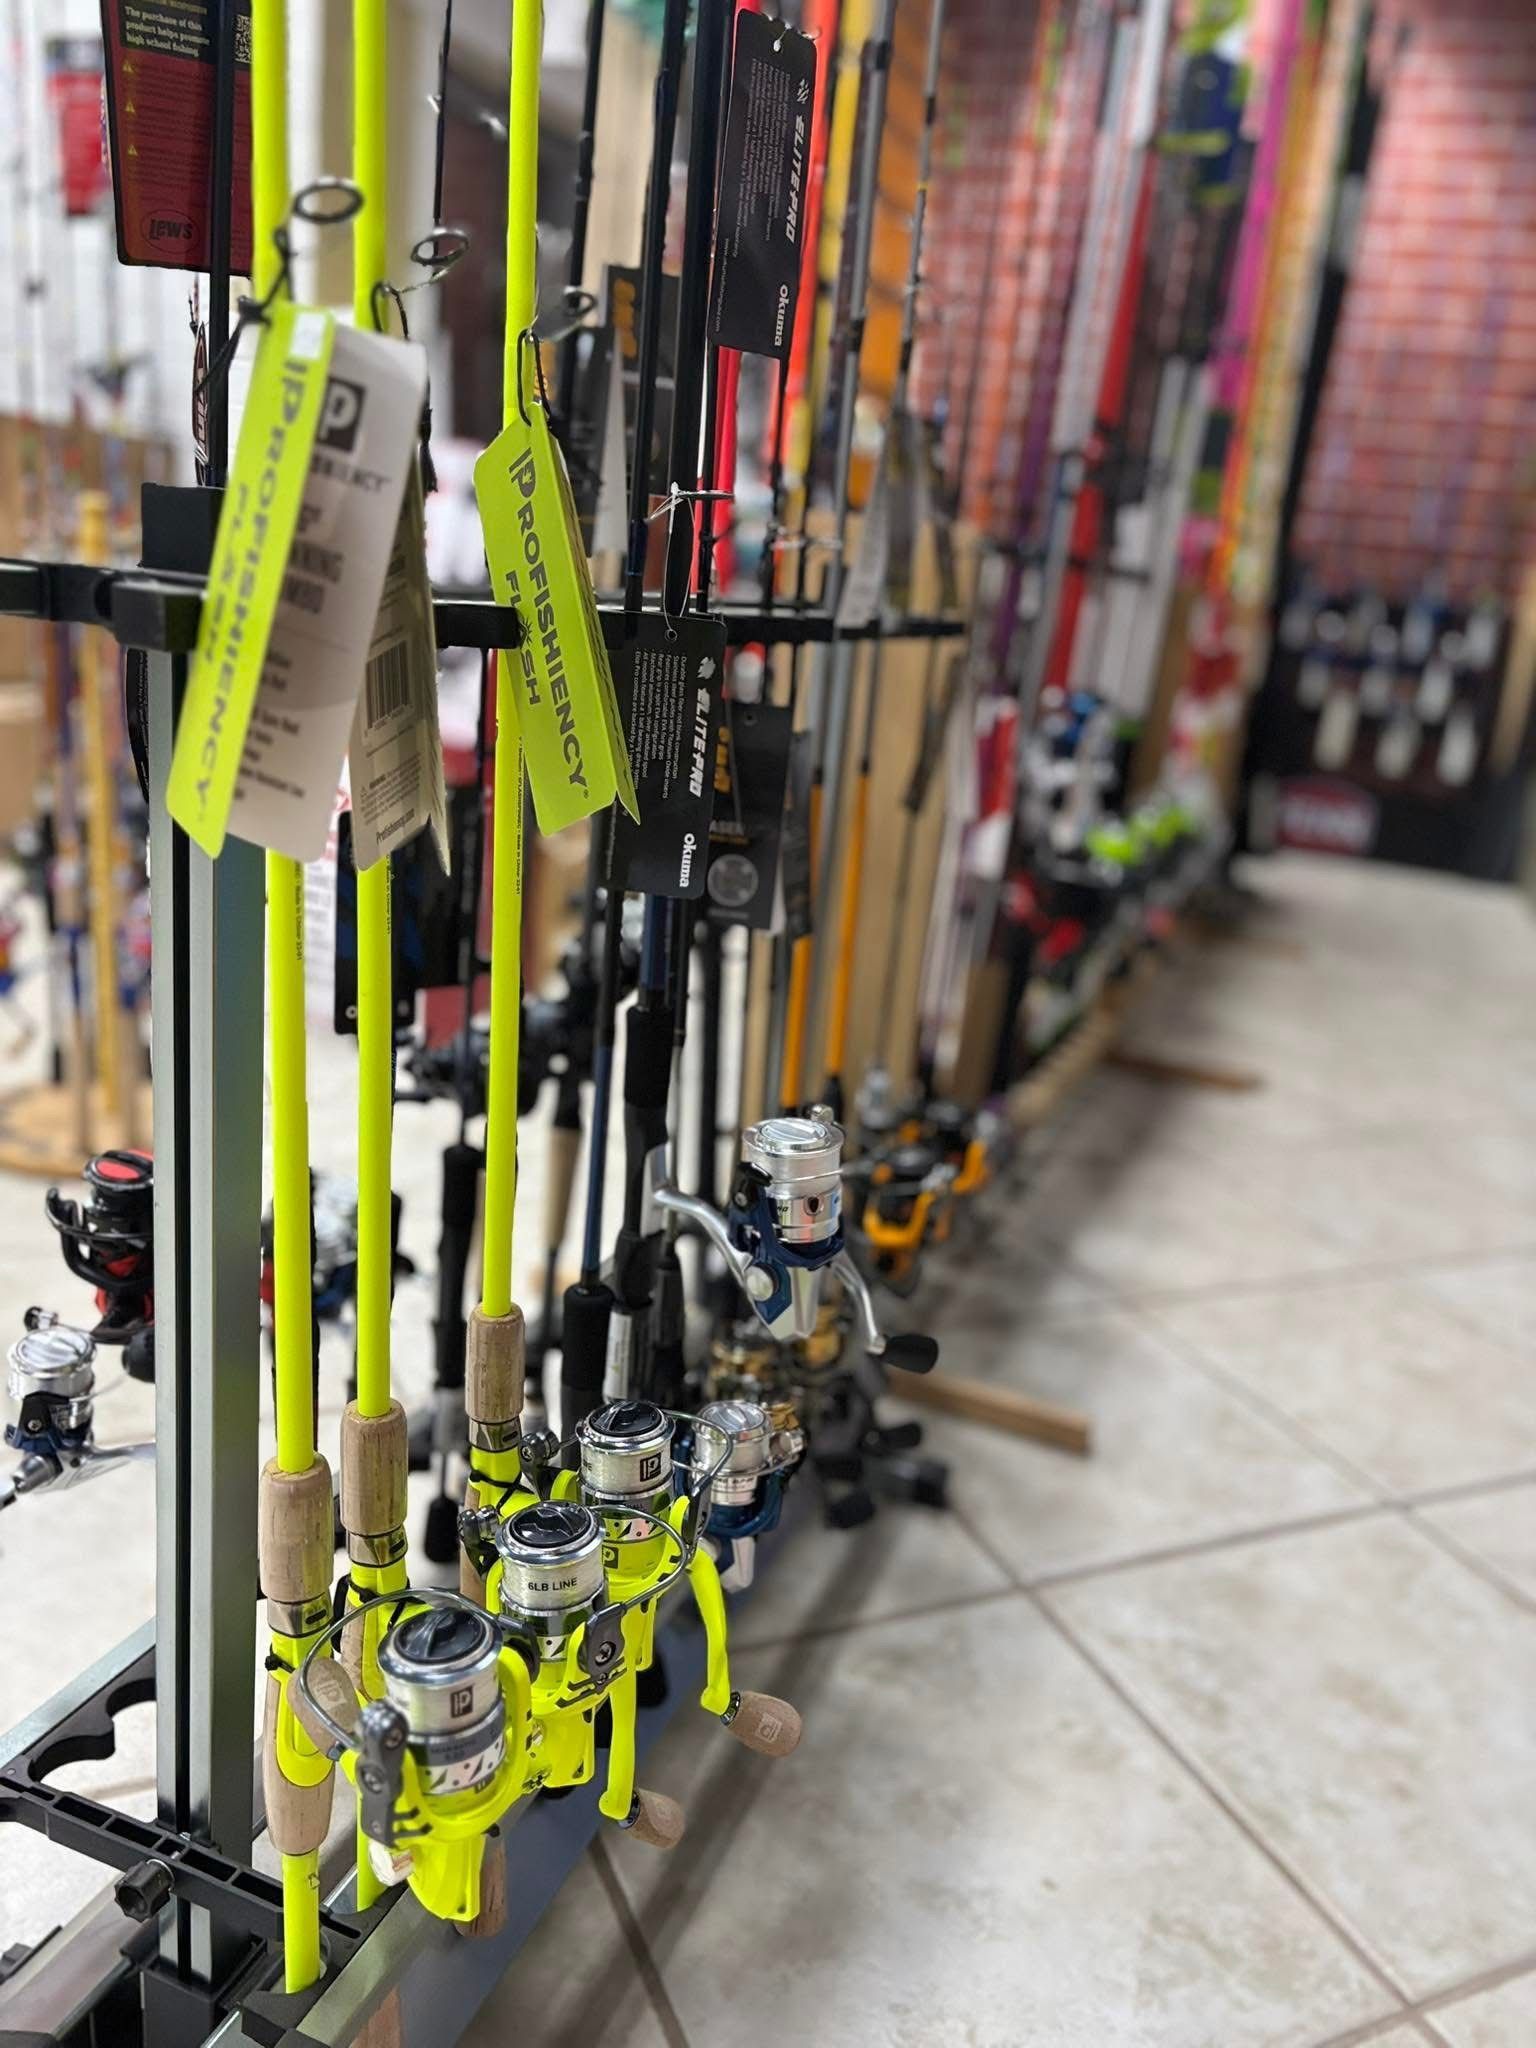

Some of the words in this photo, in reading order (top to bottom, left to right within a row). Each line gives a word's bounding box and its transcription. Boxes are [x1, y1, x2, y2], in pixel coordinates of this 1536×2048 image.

[124, 6, 141, 17] The
[142, 11, 178, 25] purchase
[179, 19, 187, 28] of
[126, 21, 157, 34] product
[773, 284, 789, 347] okuma
[680, 833, 697, 888] okuma
[528, 1580, 549, 1592] 6LB
[552, 1577, 578, 1591] LINE
